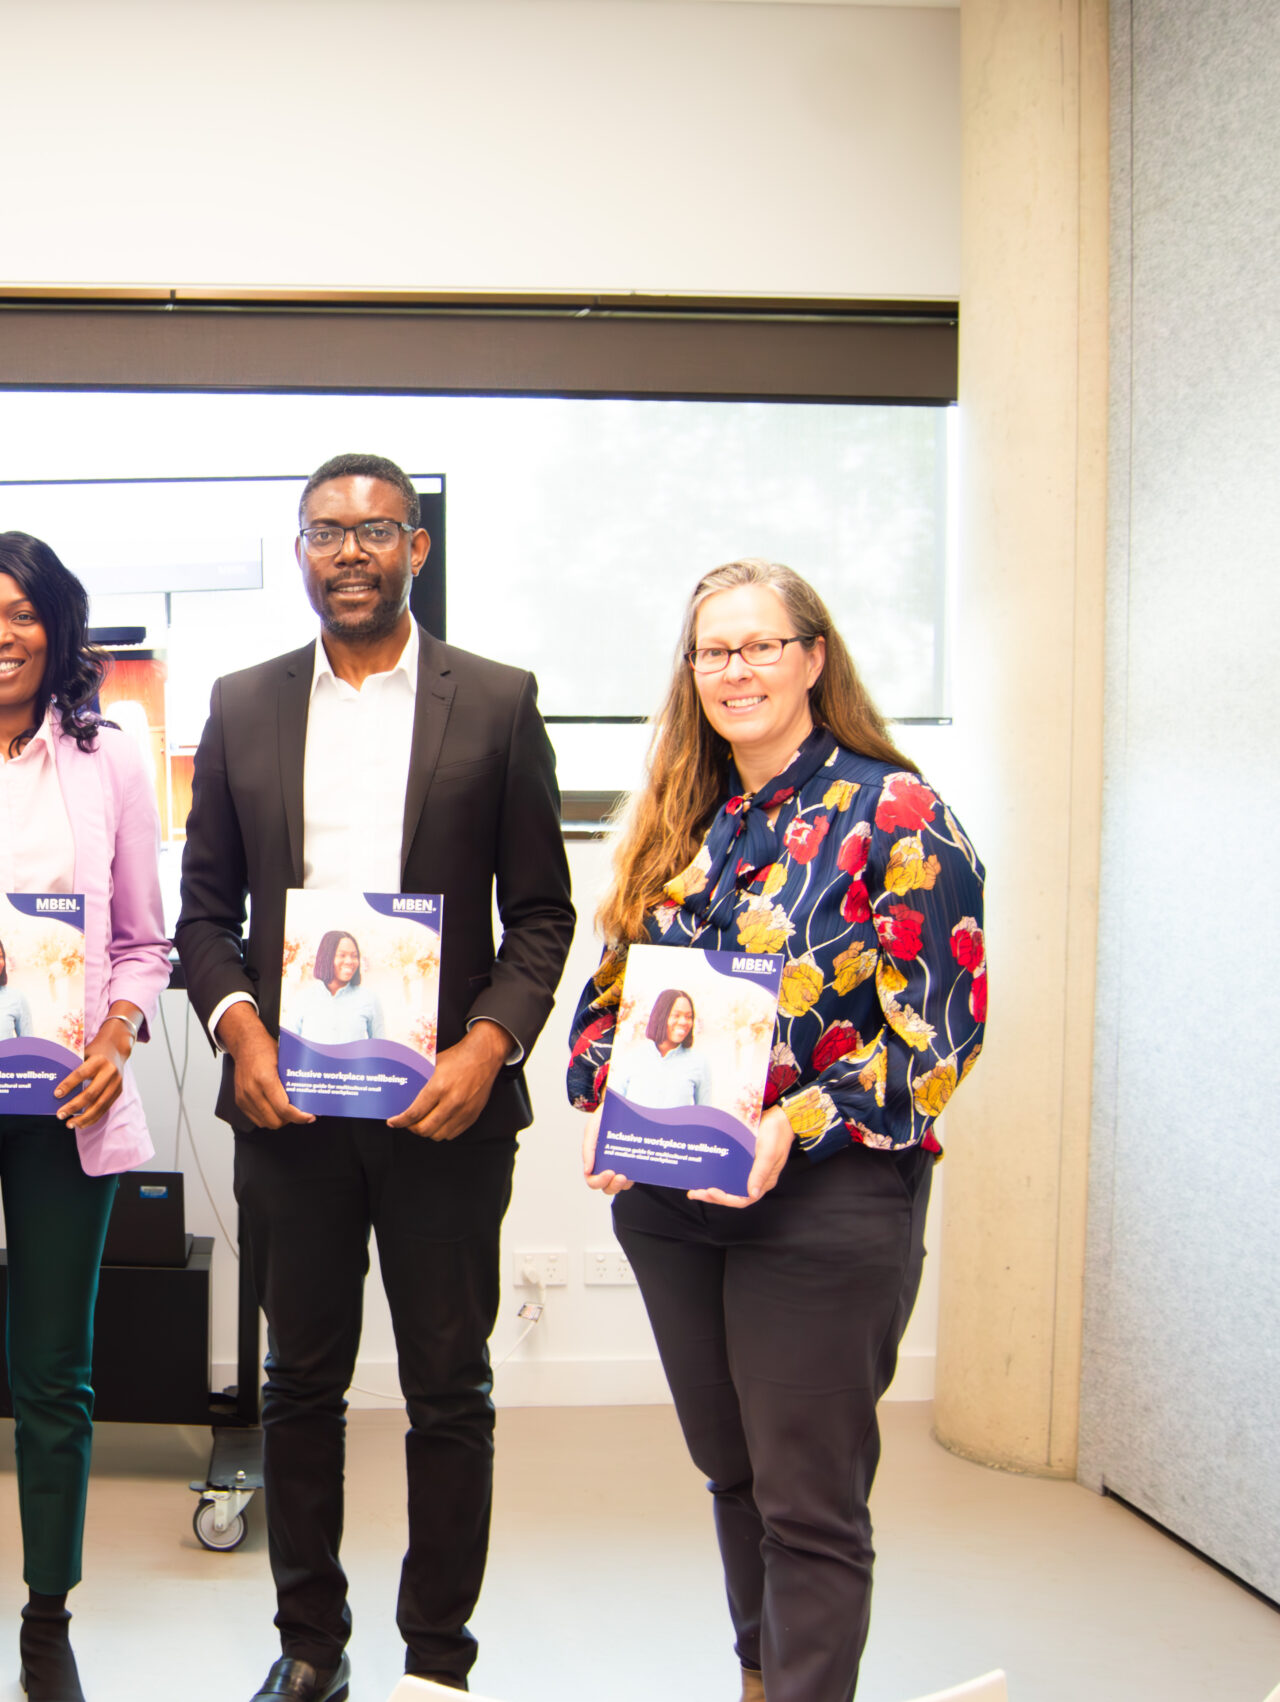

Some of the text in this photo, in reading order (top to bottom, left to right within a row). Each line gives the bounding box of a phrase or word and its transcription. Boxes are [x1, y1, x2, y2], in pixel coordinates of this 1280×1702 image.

[36, 898, 80, 911] MBEN.
[393, 898, 437, 912] MBEN.
[732, 957, 777, 972] MBEN.
[16, 1071, 57, 1081] wellbeing:
[287, 1069, 408, 1085] Inclusive workplace wellbeing:
[607, 1131, 642, 1143] Inclusive
[644, 1137, 686, 1149] workplace
